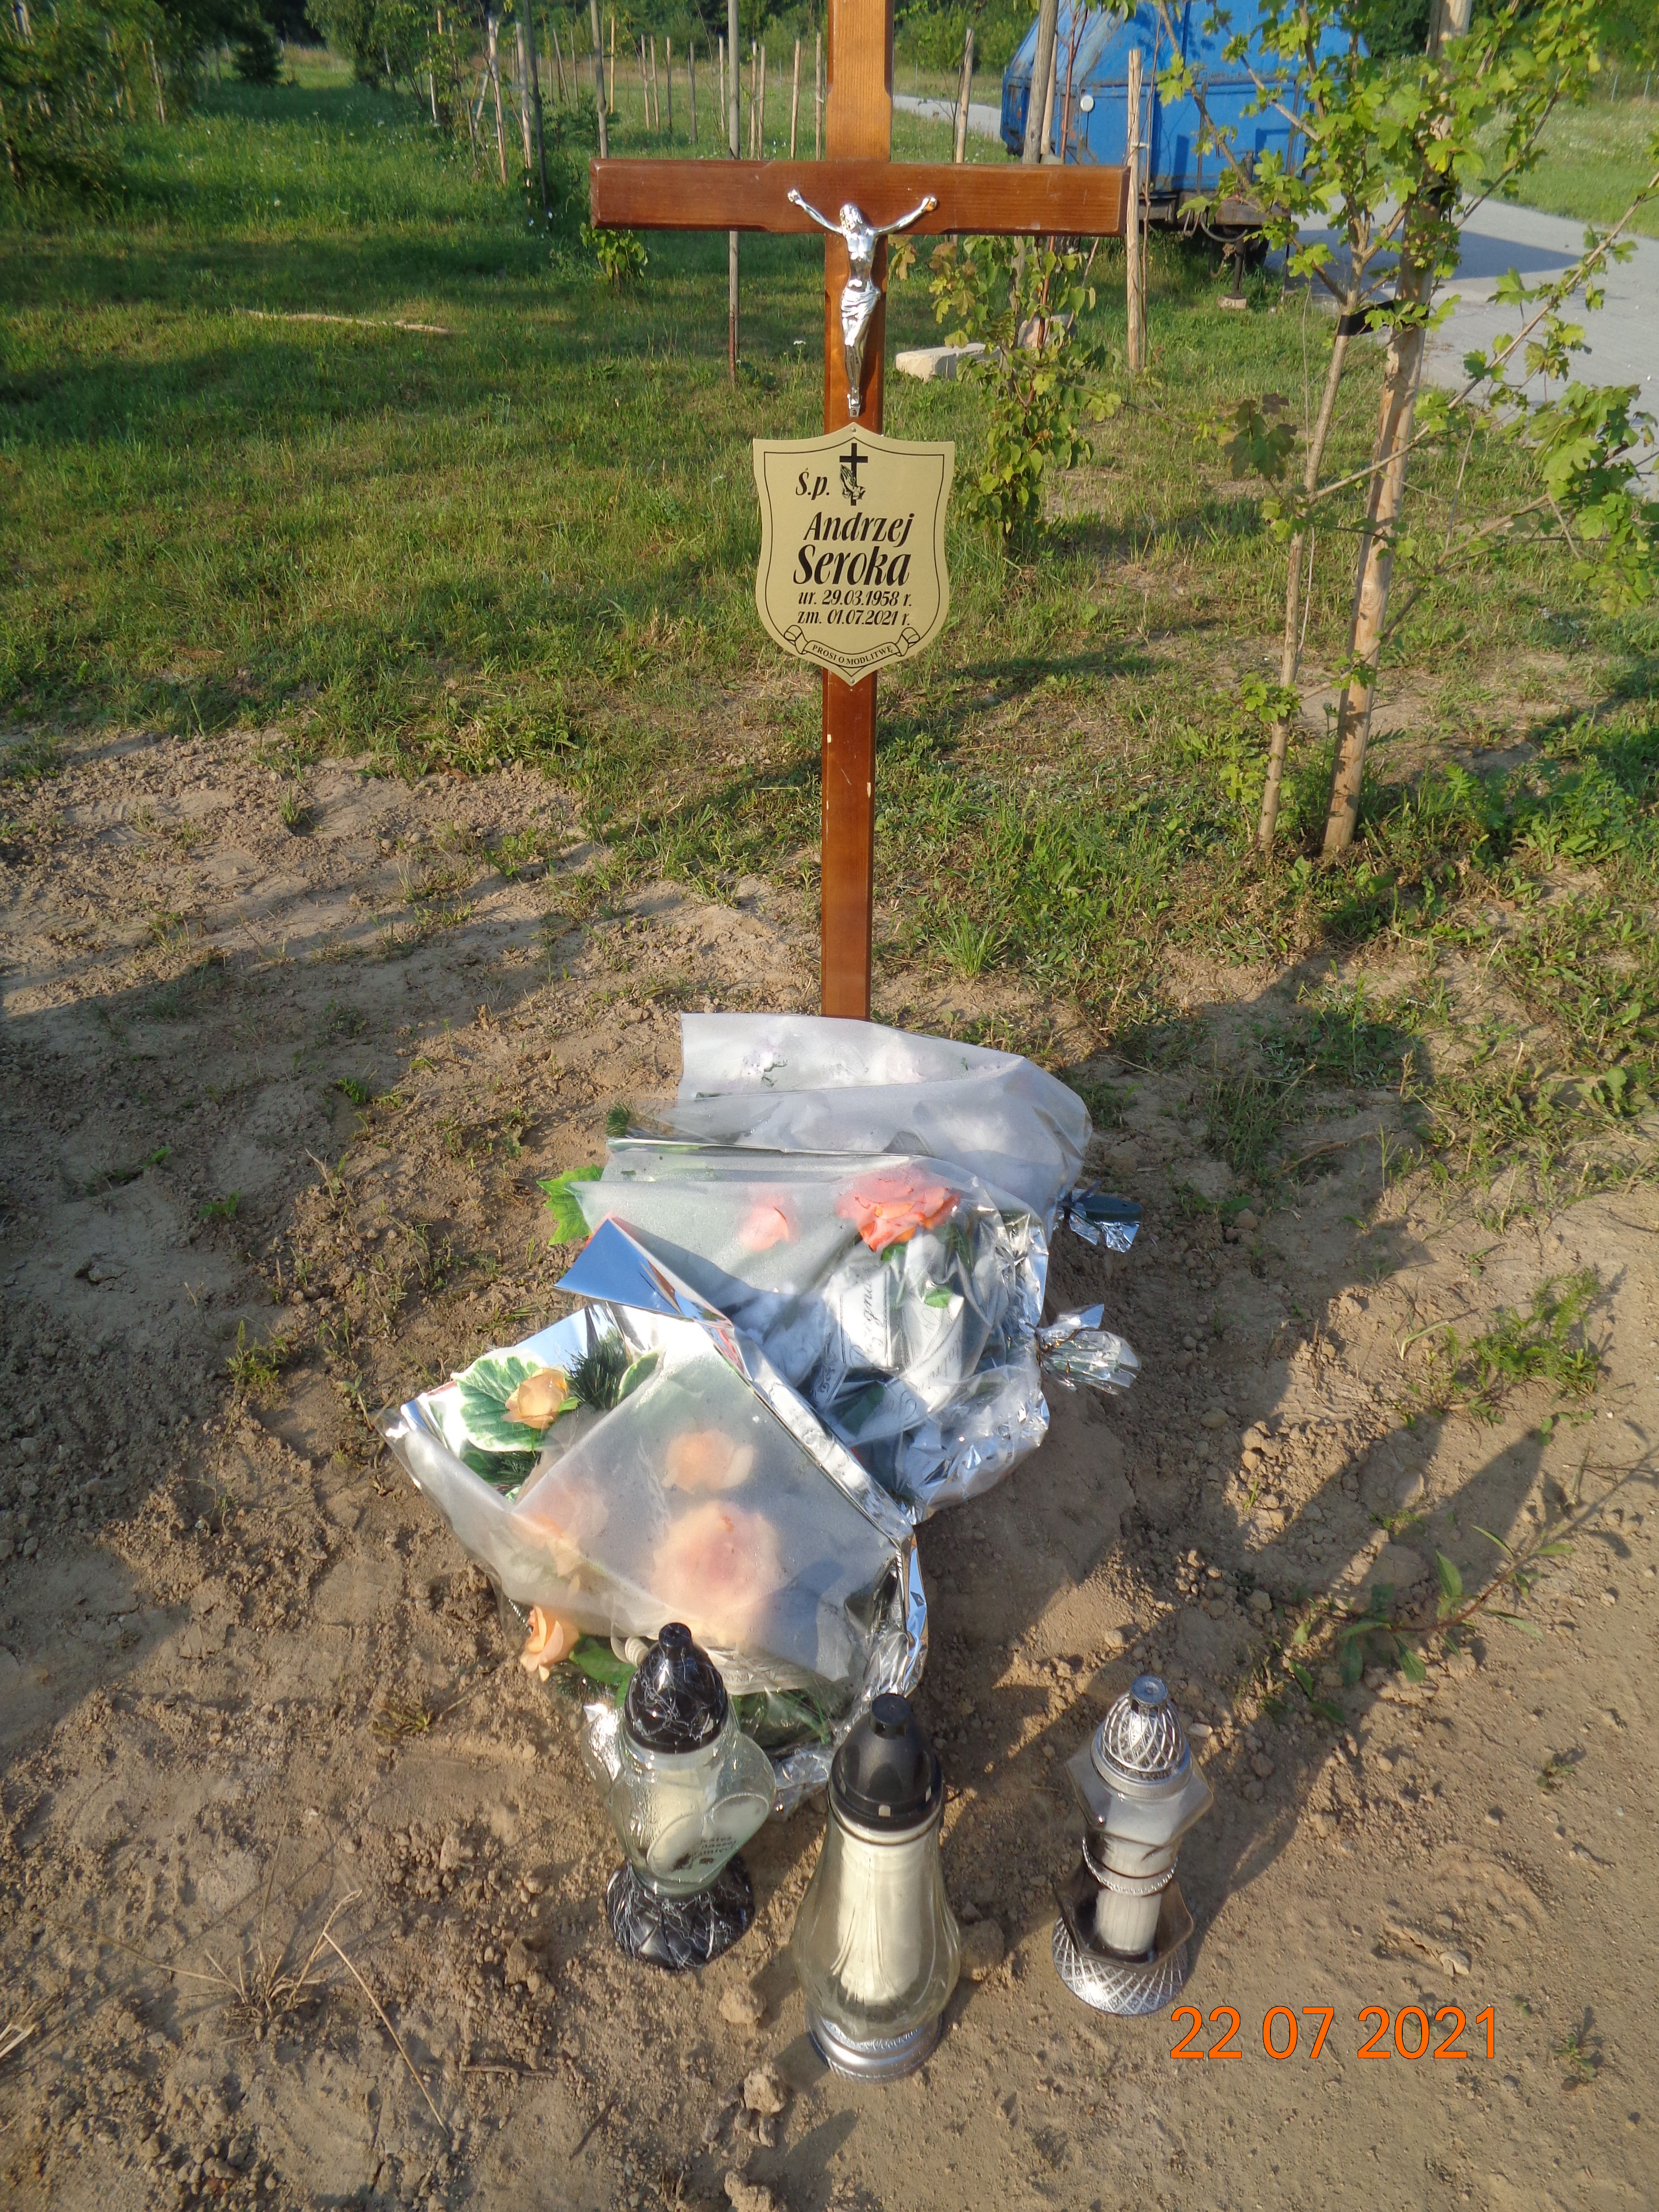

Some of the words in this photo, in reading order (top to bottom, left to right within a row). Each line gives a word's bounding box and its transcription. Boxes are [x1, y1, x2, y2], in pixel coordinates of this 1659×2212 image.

[796, 468, 830, 501] Ś.p.
[803, 511, 915, 548] Andrzej
[793, 544, 912, 586] Seroka
[798, 592, 817, 605] ur.
[822, 589, 900, 607] 29.03.1958
[903, 594, 912, 607] r.
[797, 611, 822, 624] zm.
[827, 609, 899, 626] 01.07.2021
[901, 613, 910, 626] r.
[811, 644, 837, 661] PROSI
[846, 645, 893, 665] MODLITWĘ
